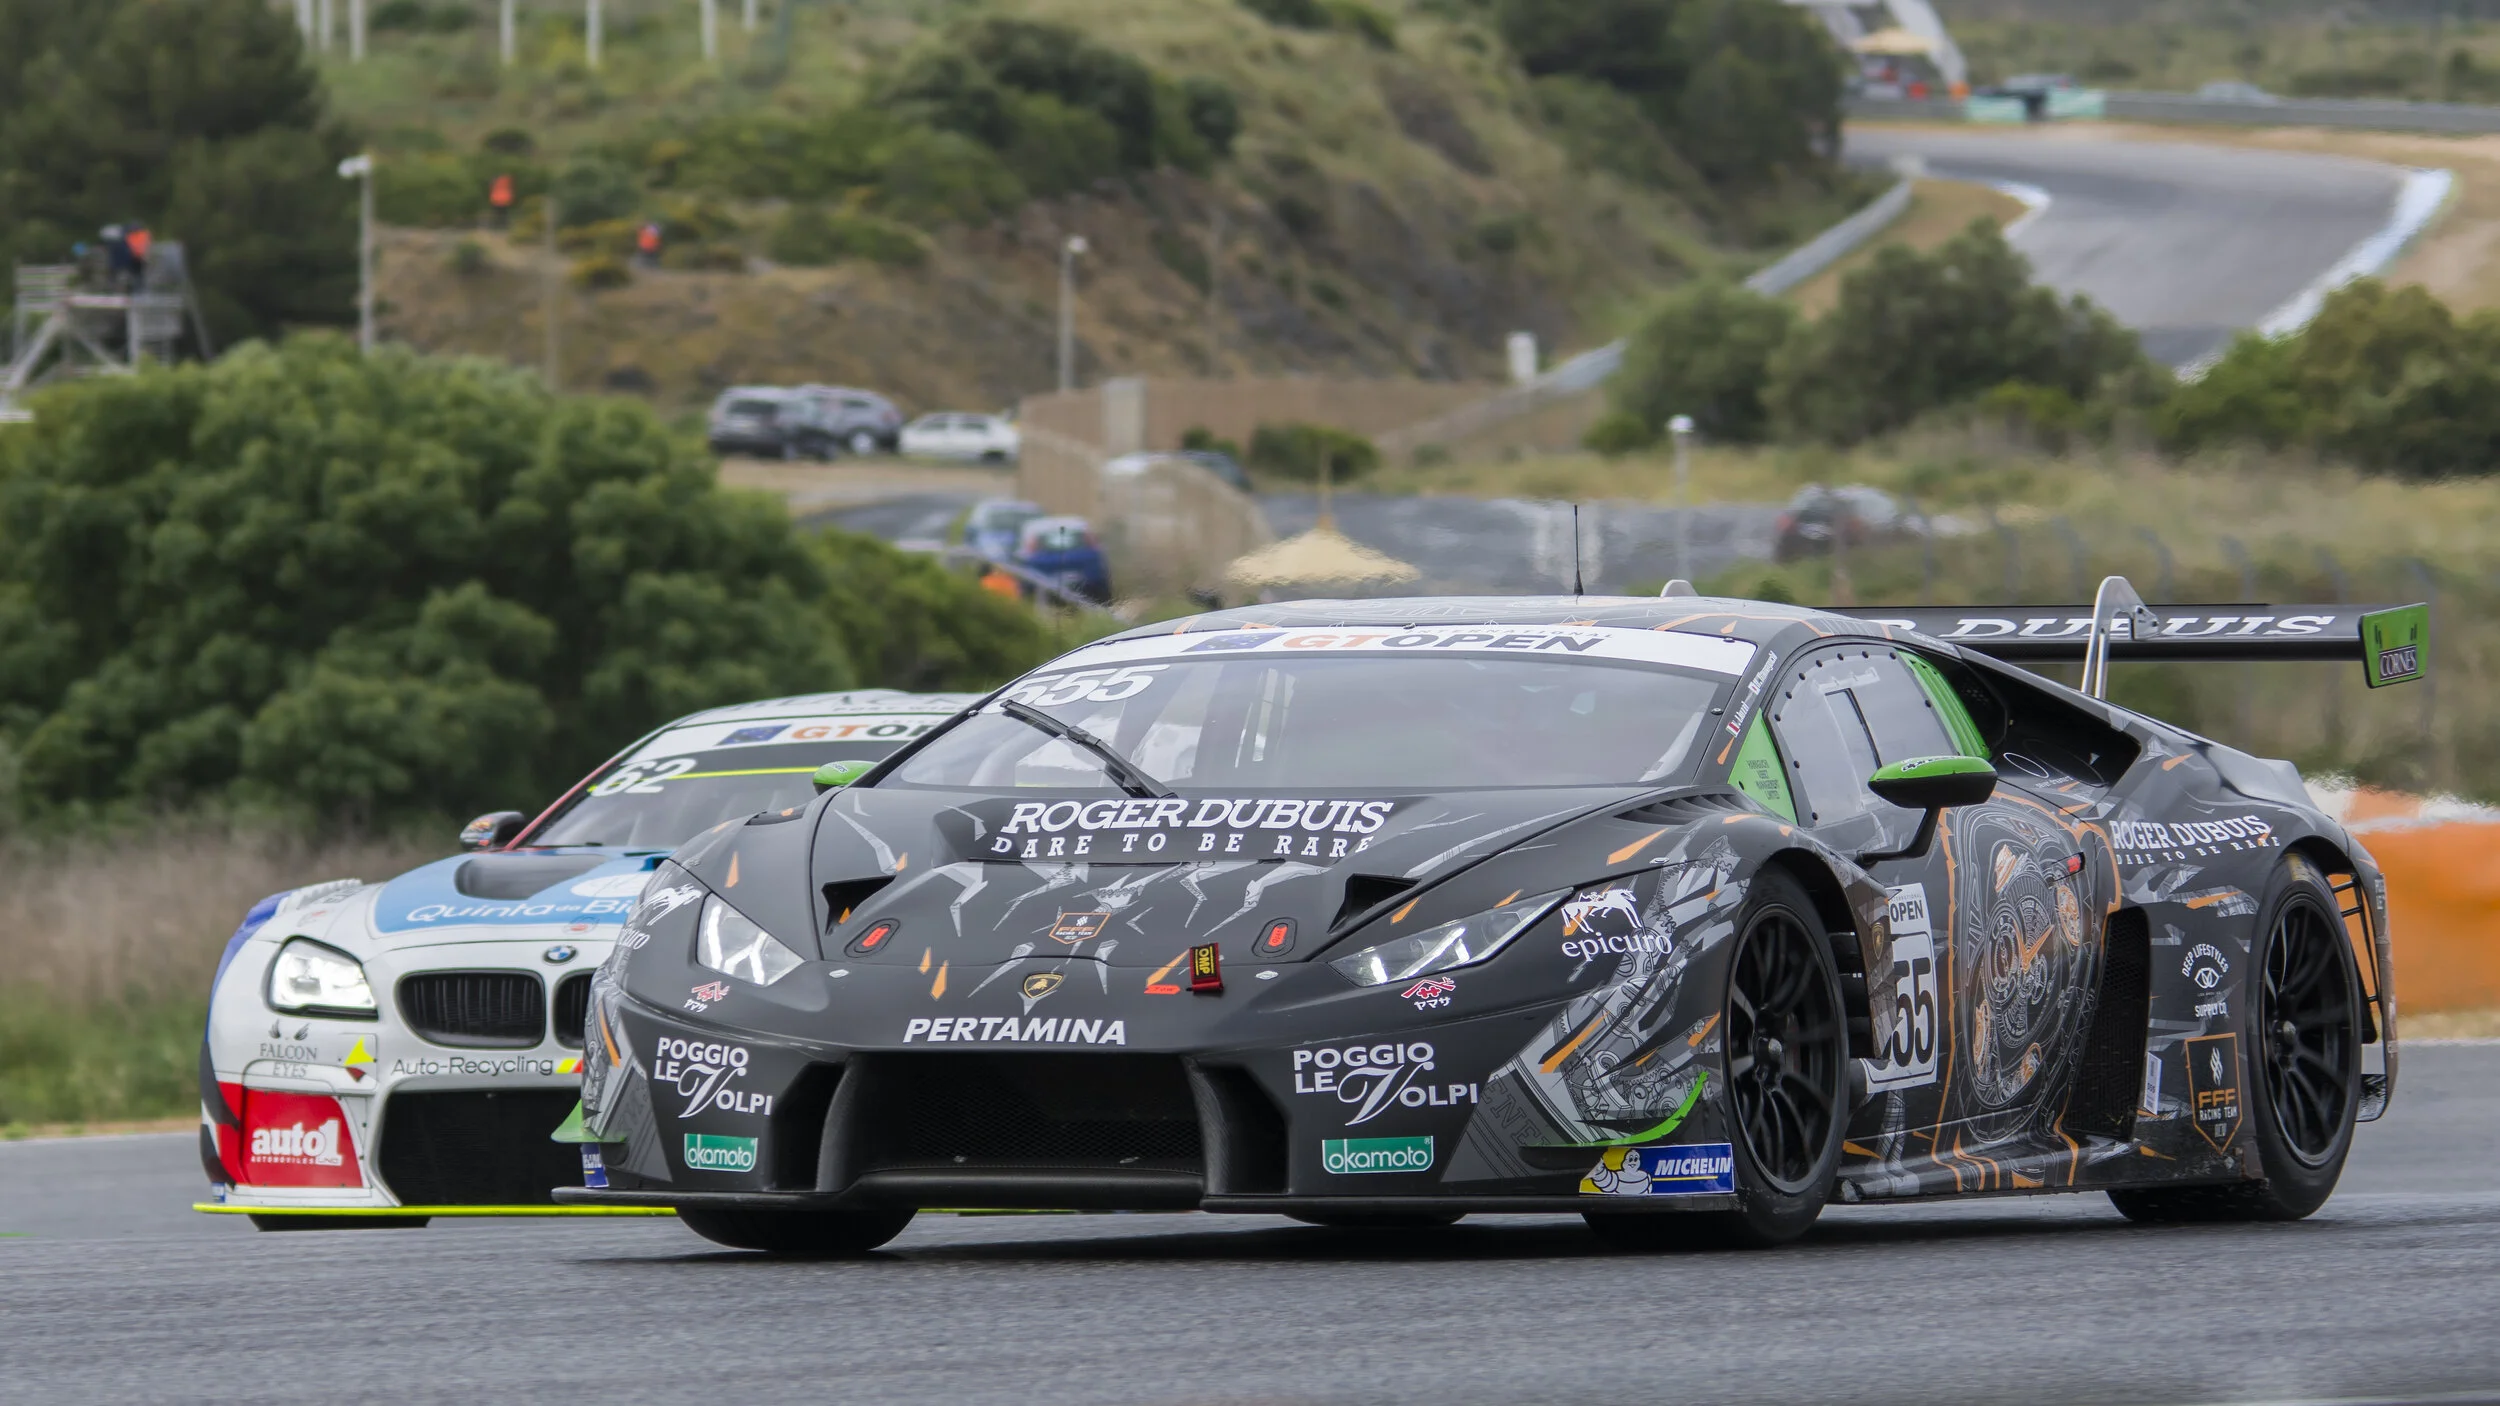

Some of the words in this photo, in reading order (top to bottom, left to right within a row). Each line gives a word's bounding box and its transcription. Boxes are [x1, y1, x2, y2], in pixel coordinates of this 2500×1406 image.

[2379, 650, 2418, 679] CORNES
[982, 664, 1170, 714] 555
[590, 758, 697, 797] 62
[1001, 800, 1188, 834] ROGER
[1187, 800, 1394, 834] DUBUIS
[991, 835, 1093, 858] DARE
[1122, 833, 1166, 852] TO
[1197, 834, 1243, 852] BE
[1273, 835, 1374, 858] RARE
[2109, 820, 2178, 850] ROGER
[2169, 814, 2271, 846] DUBUIS
[2116, 854, 2155, 865] DARE
[2163, 852, 2185, 861] TO
[2196, 846, 2221, 857] BE
[2232, 836, 2281, 851] RARE
[406, 902, 553, 923] Quinta
[582, 899, 630, 914] Bi
[1890, 900, 1924, 922] OPEN
[1561, 930, 1672, 960] epicuro
[1198, 948, 1211, 974] OMP
[2181, 951, 2194, 978] DEEP
[2192, 943, 2229, 973] LIFESTYLES
[1413, 996, 1451, 1011] ヤマサ
[1882, 957, 1934, 1066] 55
[2194, 1003, 2219, 1018] SUPPLY
[903, 1018, 1126, 1045] PERTAMINA
[260, 1043, 318, 1061] FALCON
[657, 1037, 749, 1068] POGGIO
[1293, 1042, 1434, 1071] POGGIO
[272, 1061, 307, 1078] EYES
[391, 1056, 554, 1078] Auto-Recycling
[654, 1059, 680, 1083] LE
[677, 1063, 773, 1118] VOLPI
[1294, 1071, 1337, 1094] LE
[1337, 1061, 1478, 1126] VOLPI
[2198, 1088, 2236, 1109] FFF
[251, 1119, 340, 1159] auto1
[687, 1140, 752, 1168] okamoto
[1328, 1143, 1428, 1171] okamoto
[1654, 1157, 1732, 1176] MICHELIN
